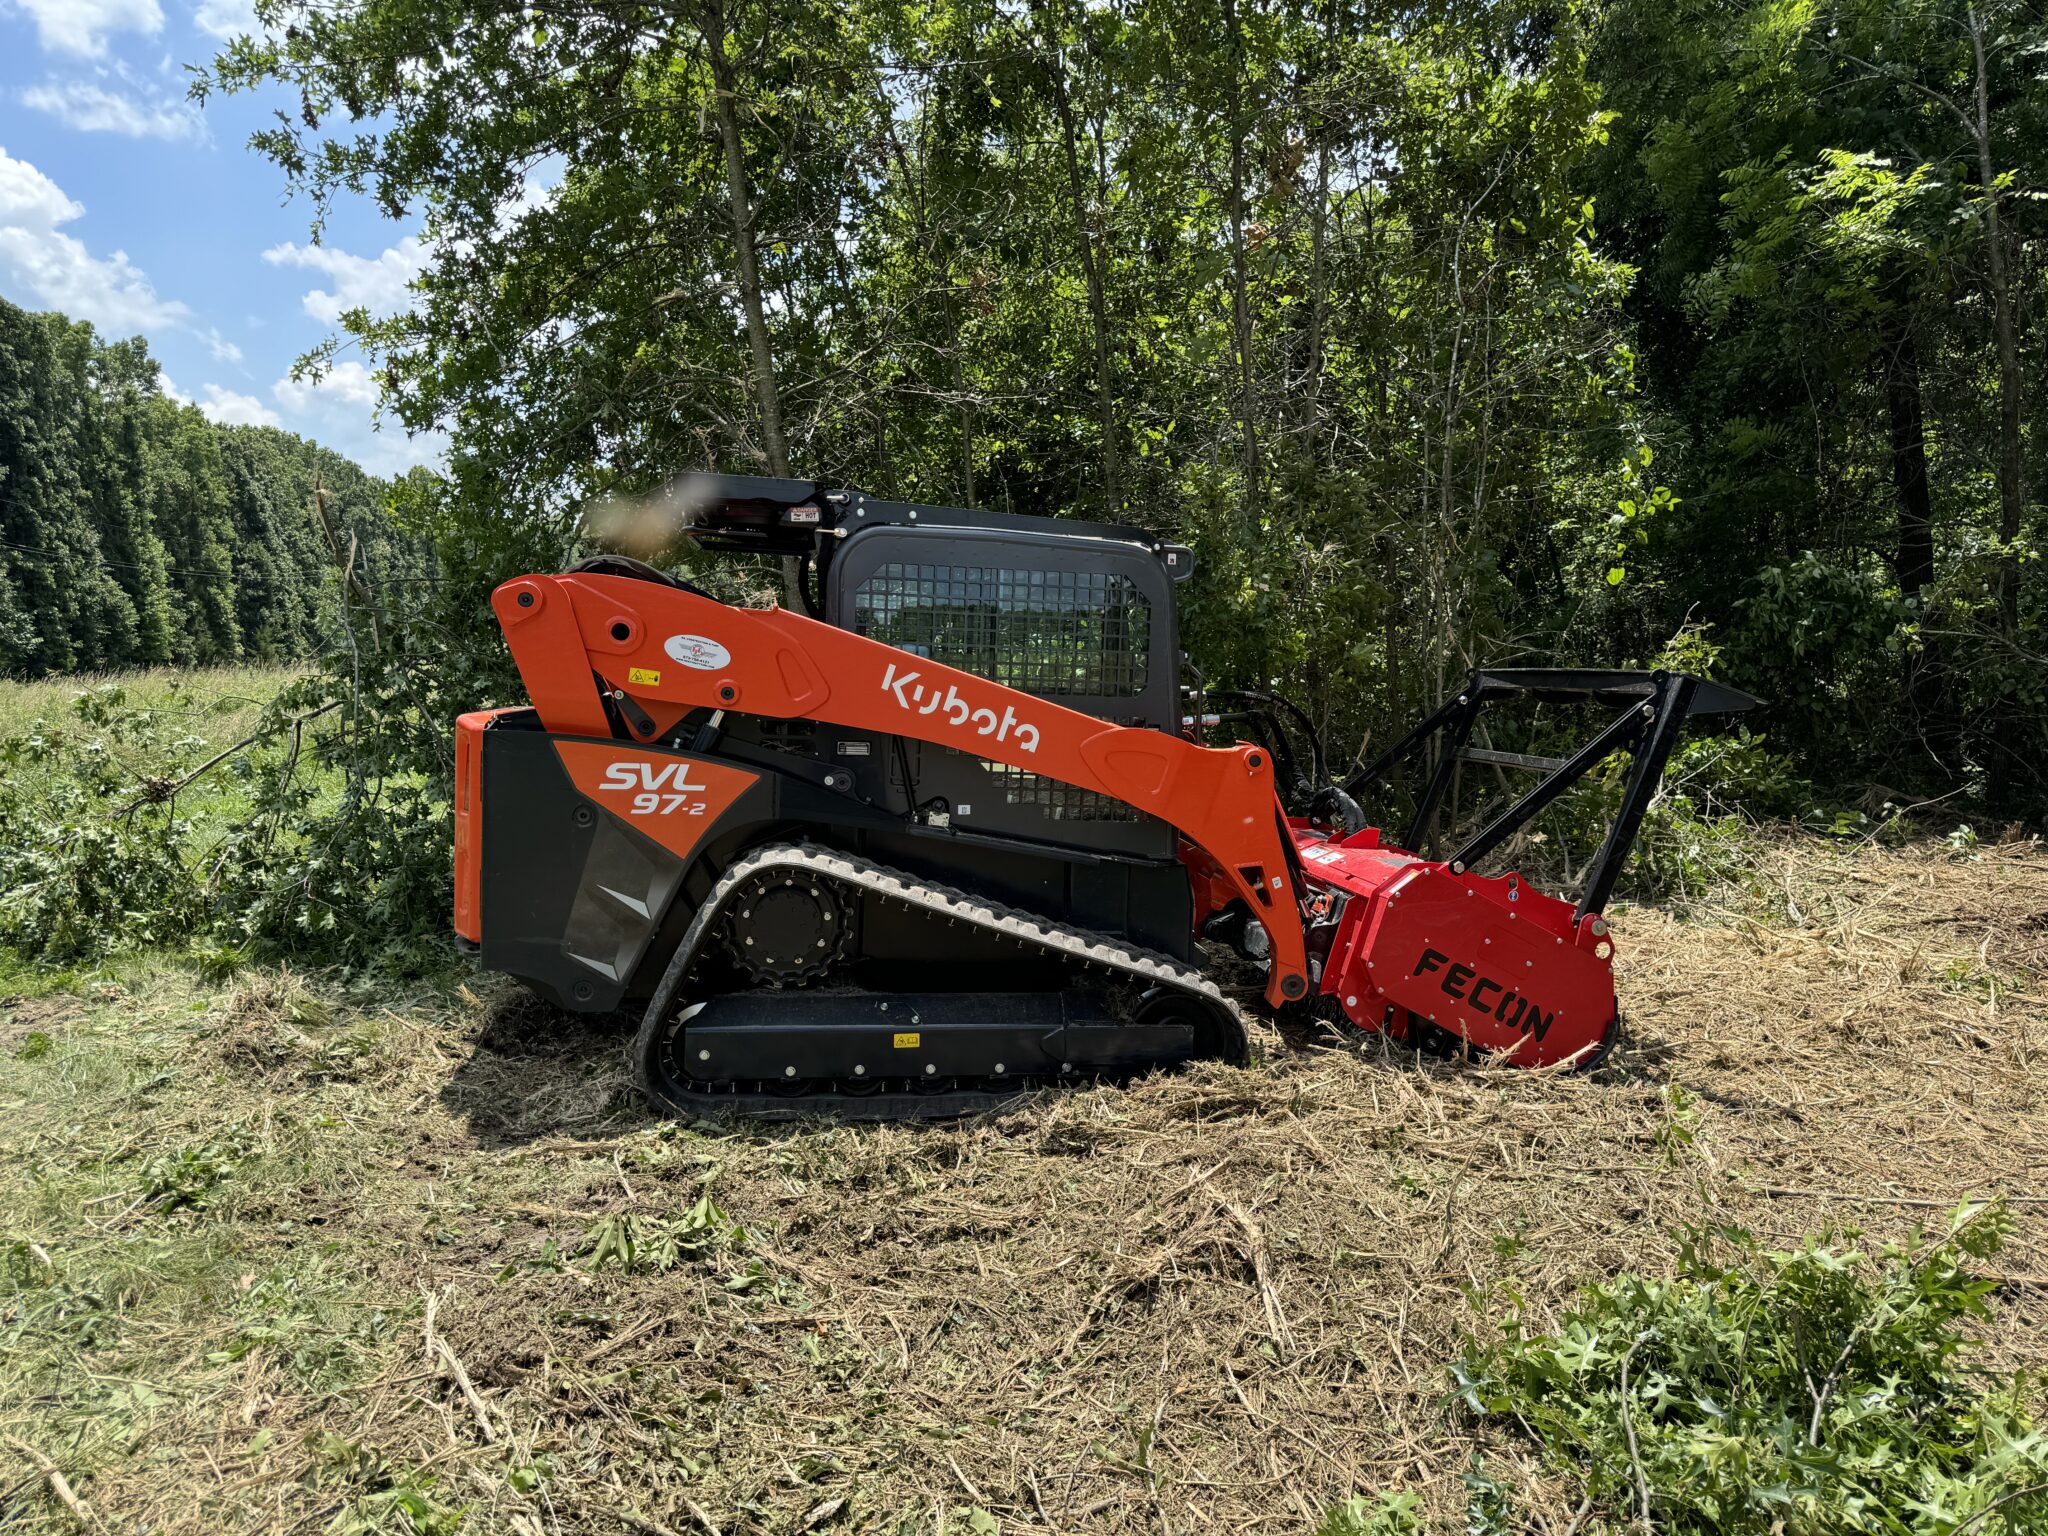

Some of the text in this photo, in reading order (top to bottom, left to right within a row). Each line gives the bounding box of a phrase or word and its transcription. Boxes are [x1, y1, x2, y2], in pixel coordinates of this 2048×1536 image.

[881, 663, 1040, 753] Kubota
[599, 762, 706, 791] SVL
[630, 793, 706, 815] 97-2
[1413, 948, 1554, 1043] FECON
